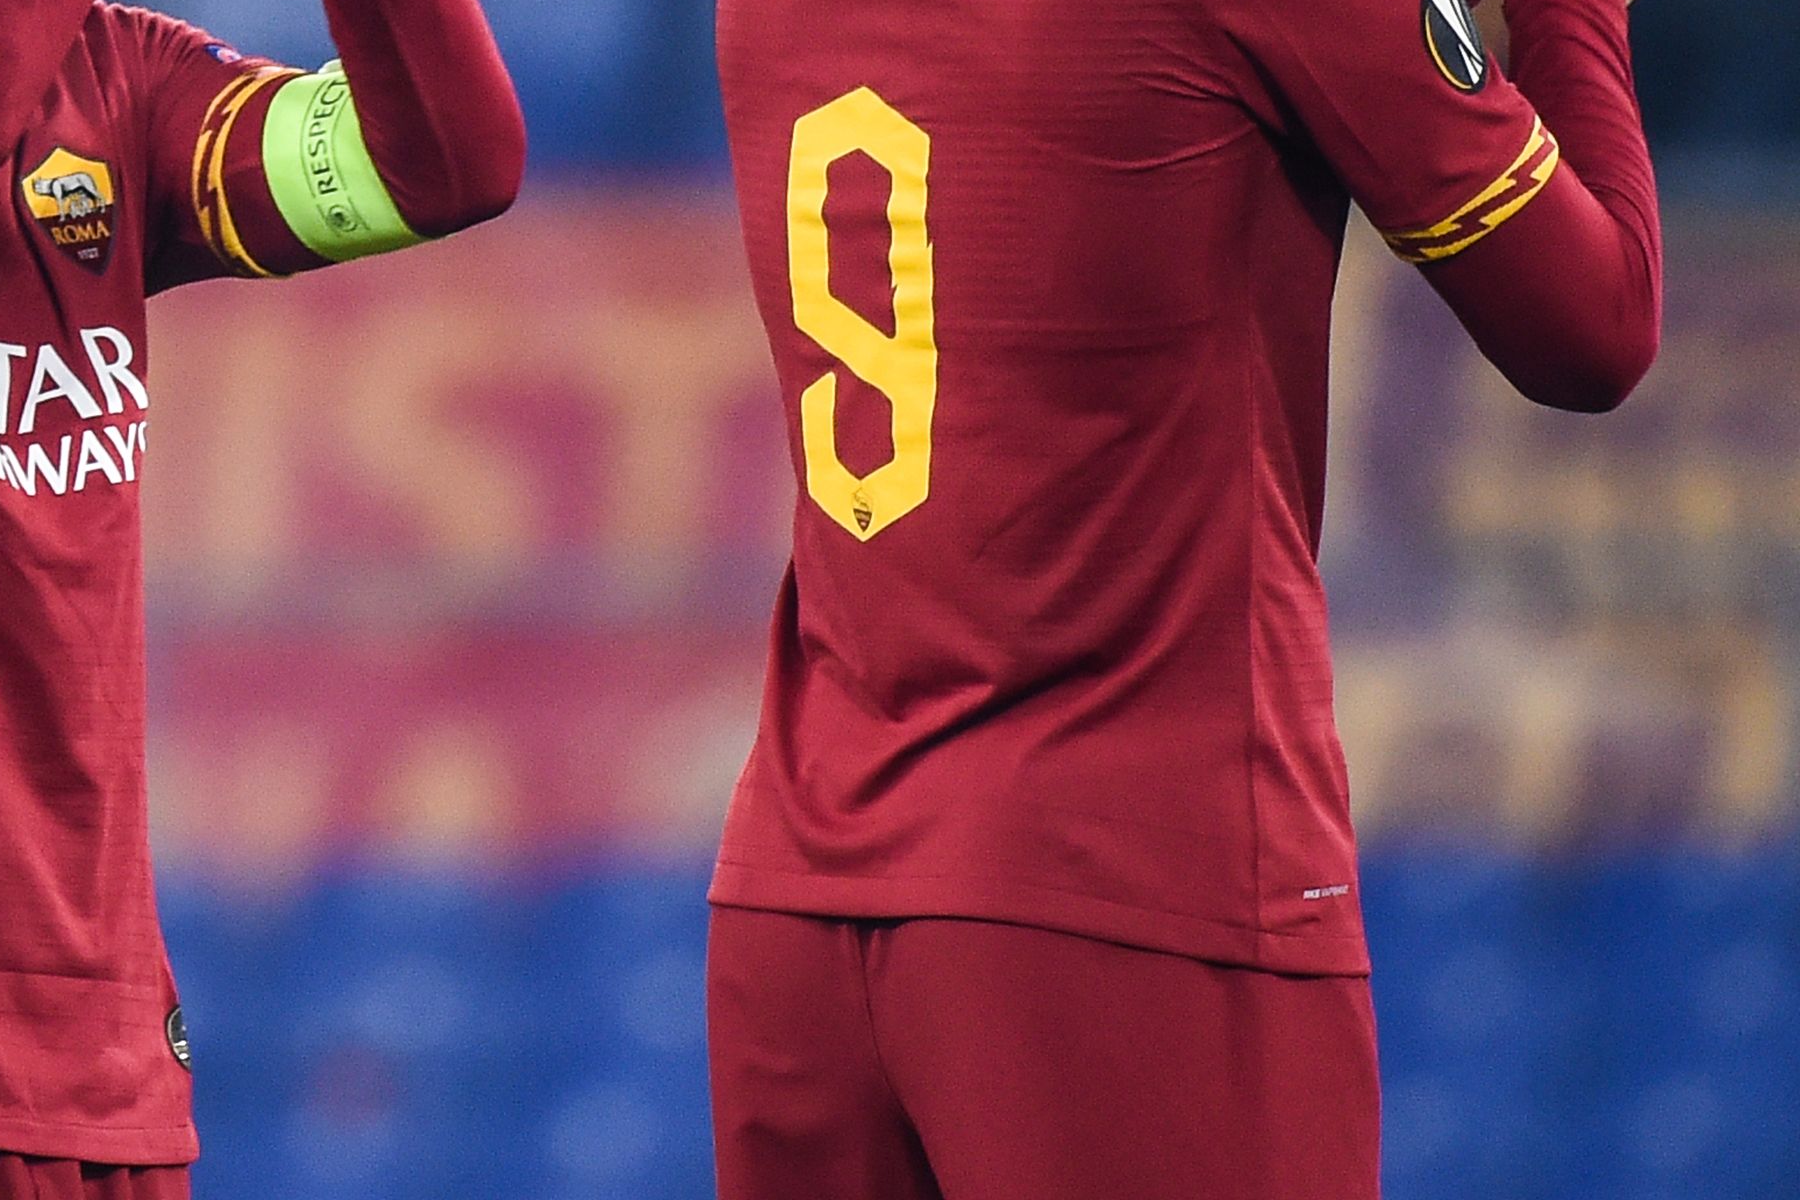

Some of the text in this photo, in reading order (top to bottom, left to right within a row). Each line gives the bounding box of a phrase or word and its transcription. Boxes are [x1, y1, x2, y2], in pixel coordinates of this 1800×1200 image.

[308, 80, 349, 195] RESPECT
[51, 220, 111, 245] ROMA
[786, 85, 938, 542] 9
